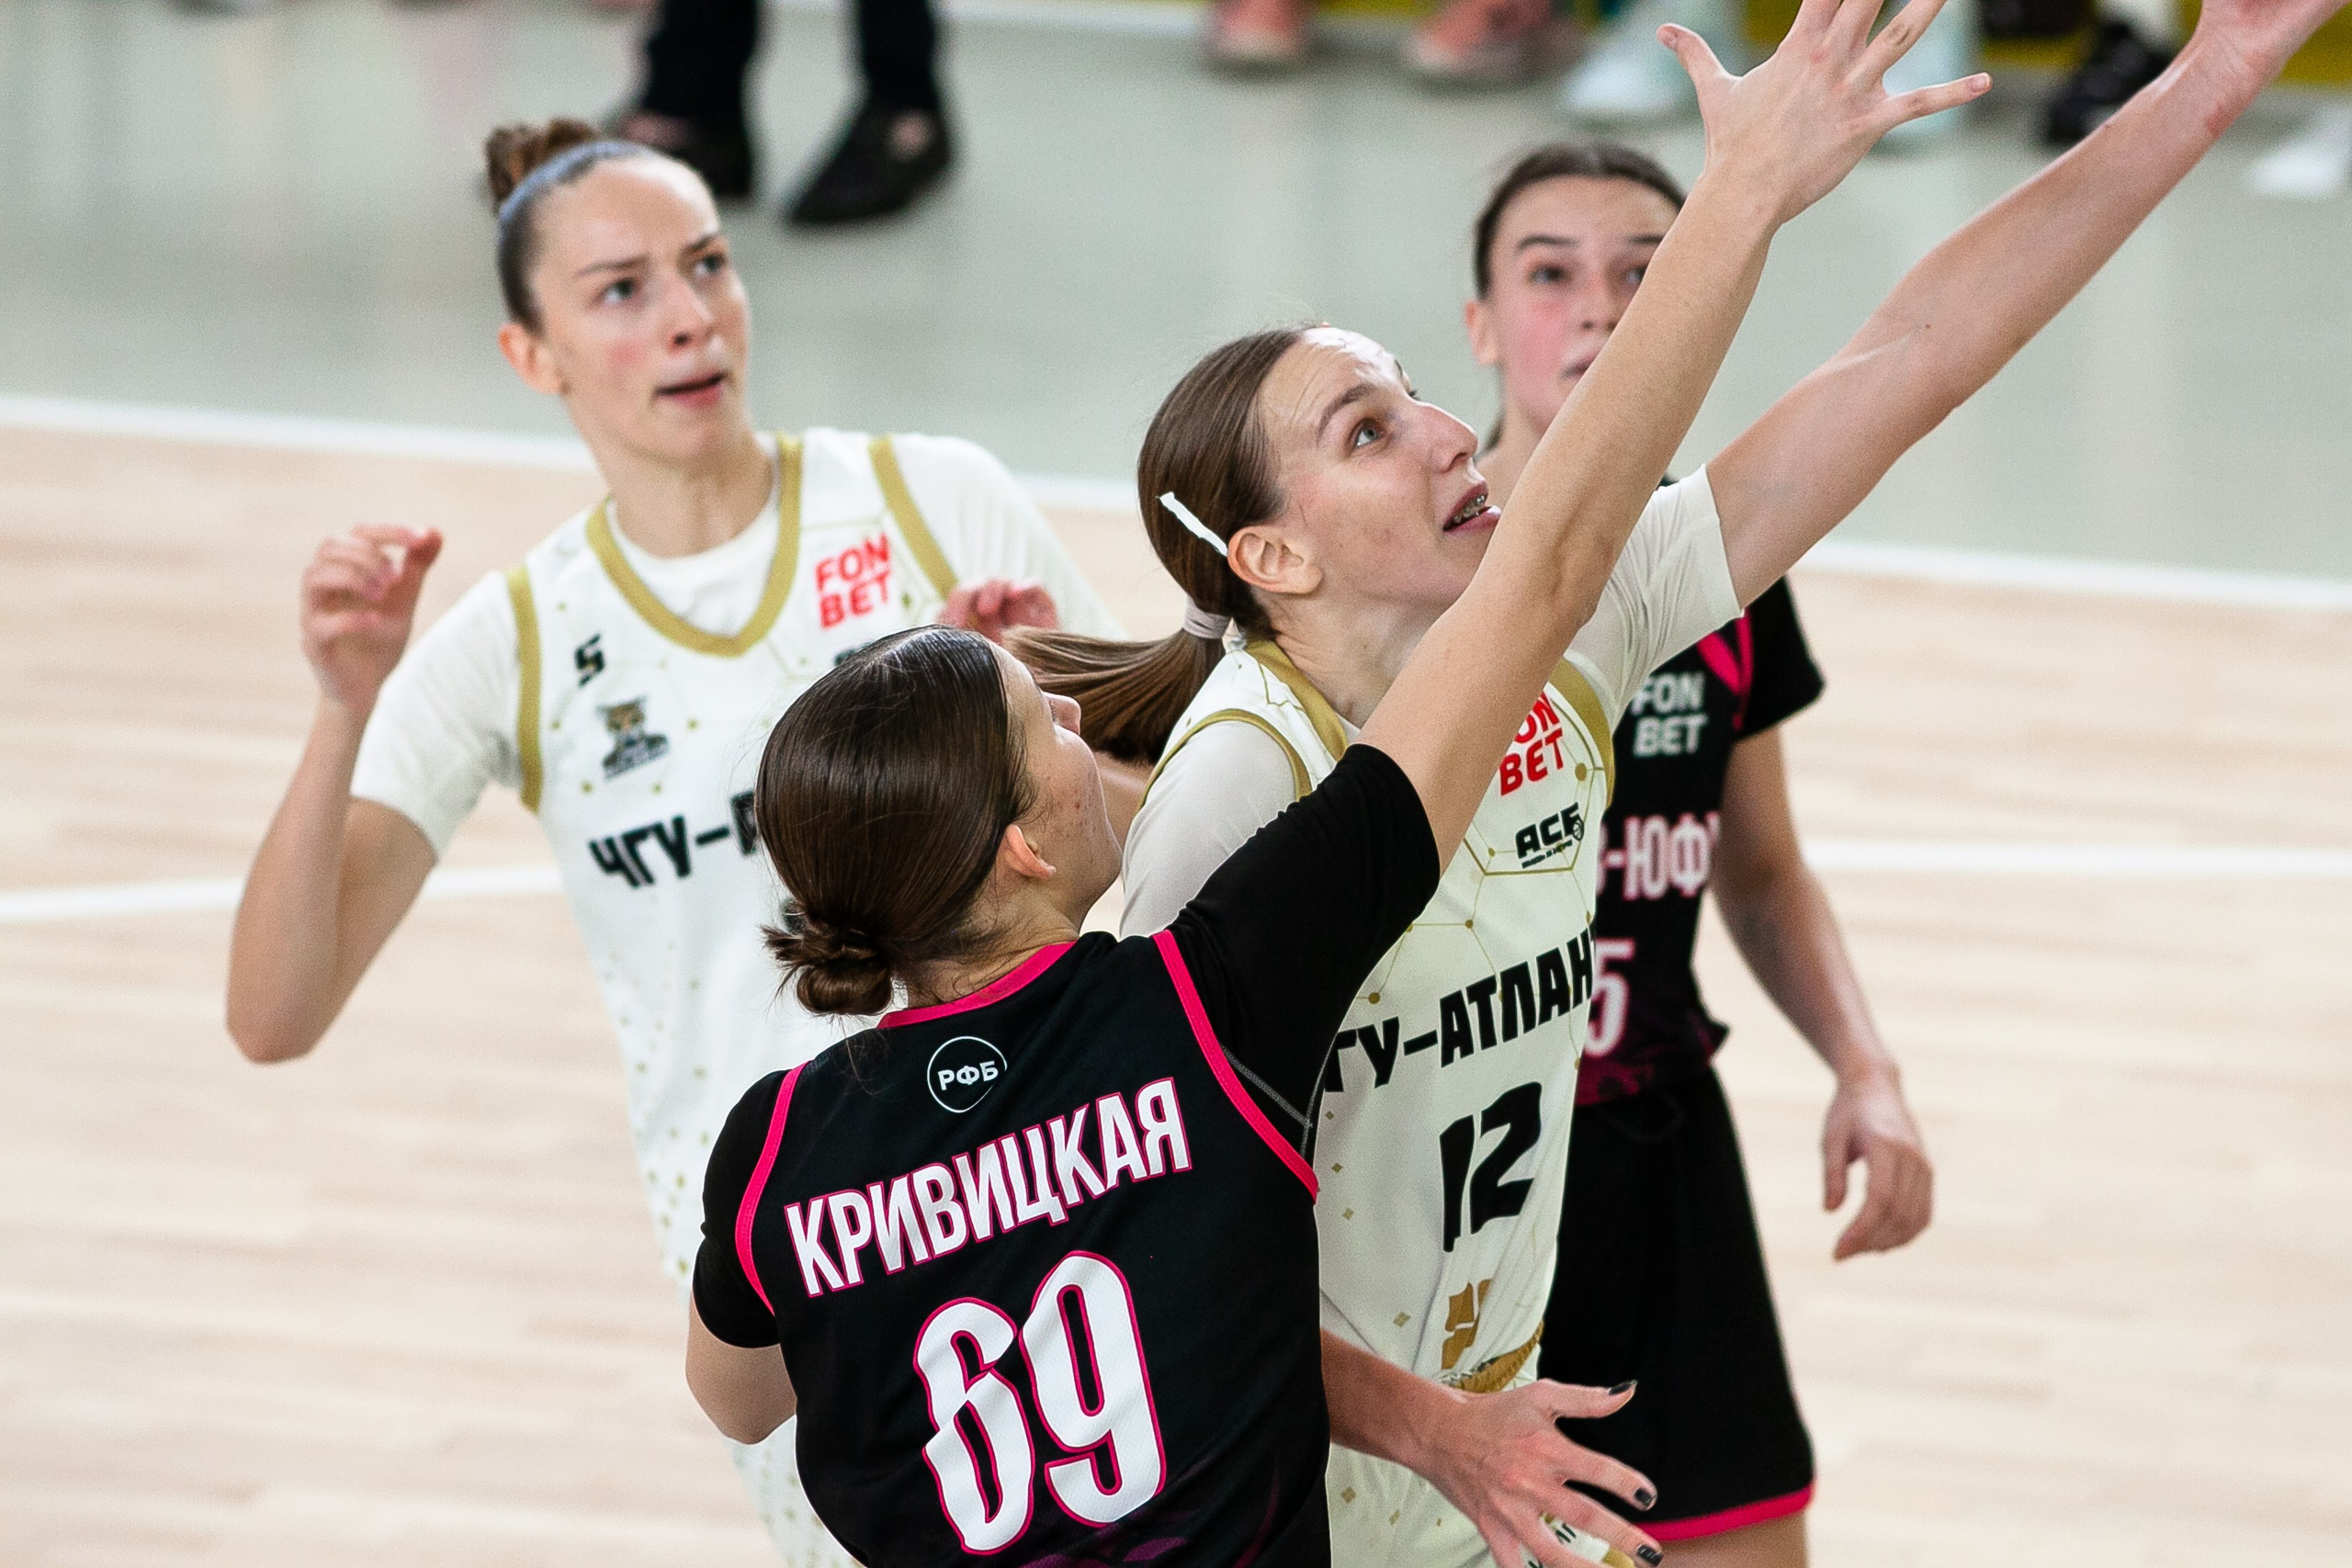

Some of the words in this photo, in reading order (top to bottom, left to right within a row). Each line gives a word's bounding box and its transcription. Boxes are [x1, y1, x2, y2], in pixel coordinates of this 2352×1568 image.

[815, 532, 890, 593] FON
[820, 569, 891, 628] BET
[1514, 691, 1560, 745] ON
[1632, 671, 1705, 716] FON
[1499, 727, 1564, 797] BET
[1634, 713, 1706, 757] BET
[1324, 928, 1595, 1093] ГУ-АТЛАН
[937, 1060, 1000, 1091] РФБ
[785, 1077, 1193, 1298] КРИВИЦКАЯ
[1439, 1081, 1543, 1253] 12
[912, 1249, 1167, 1555] 69
